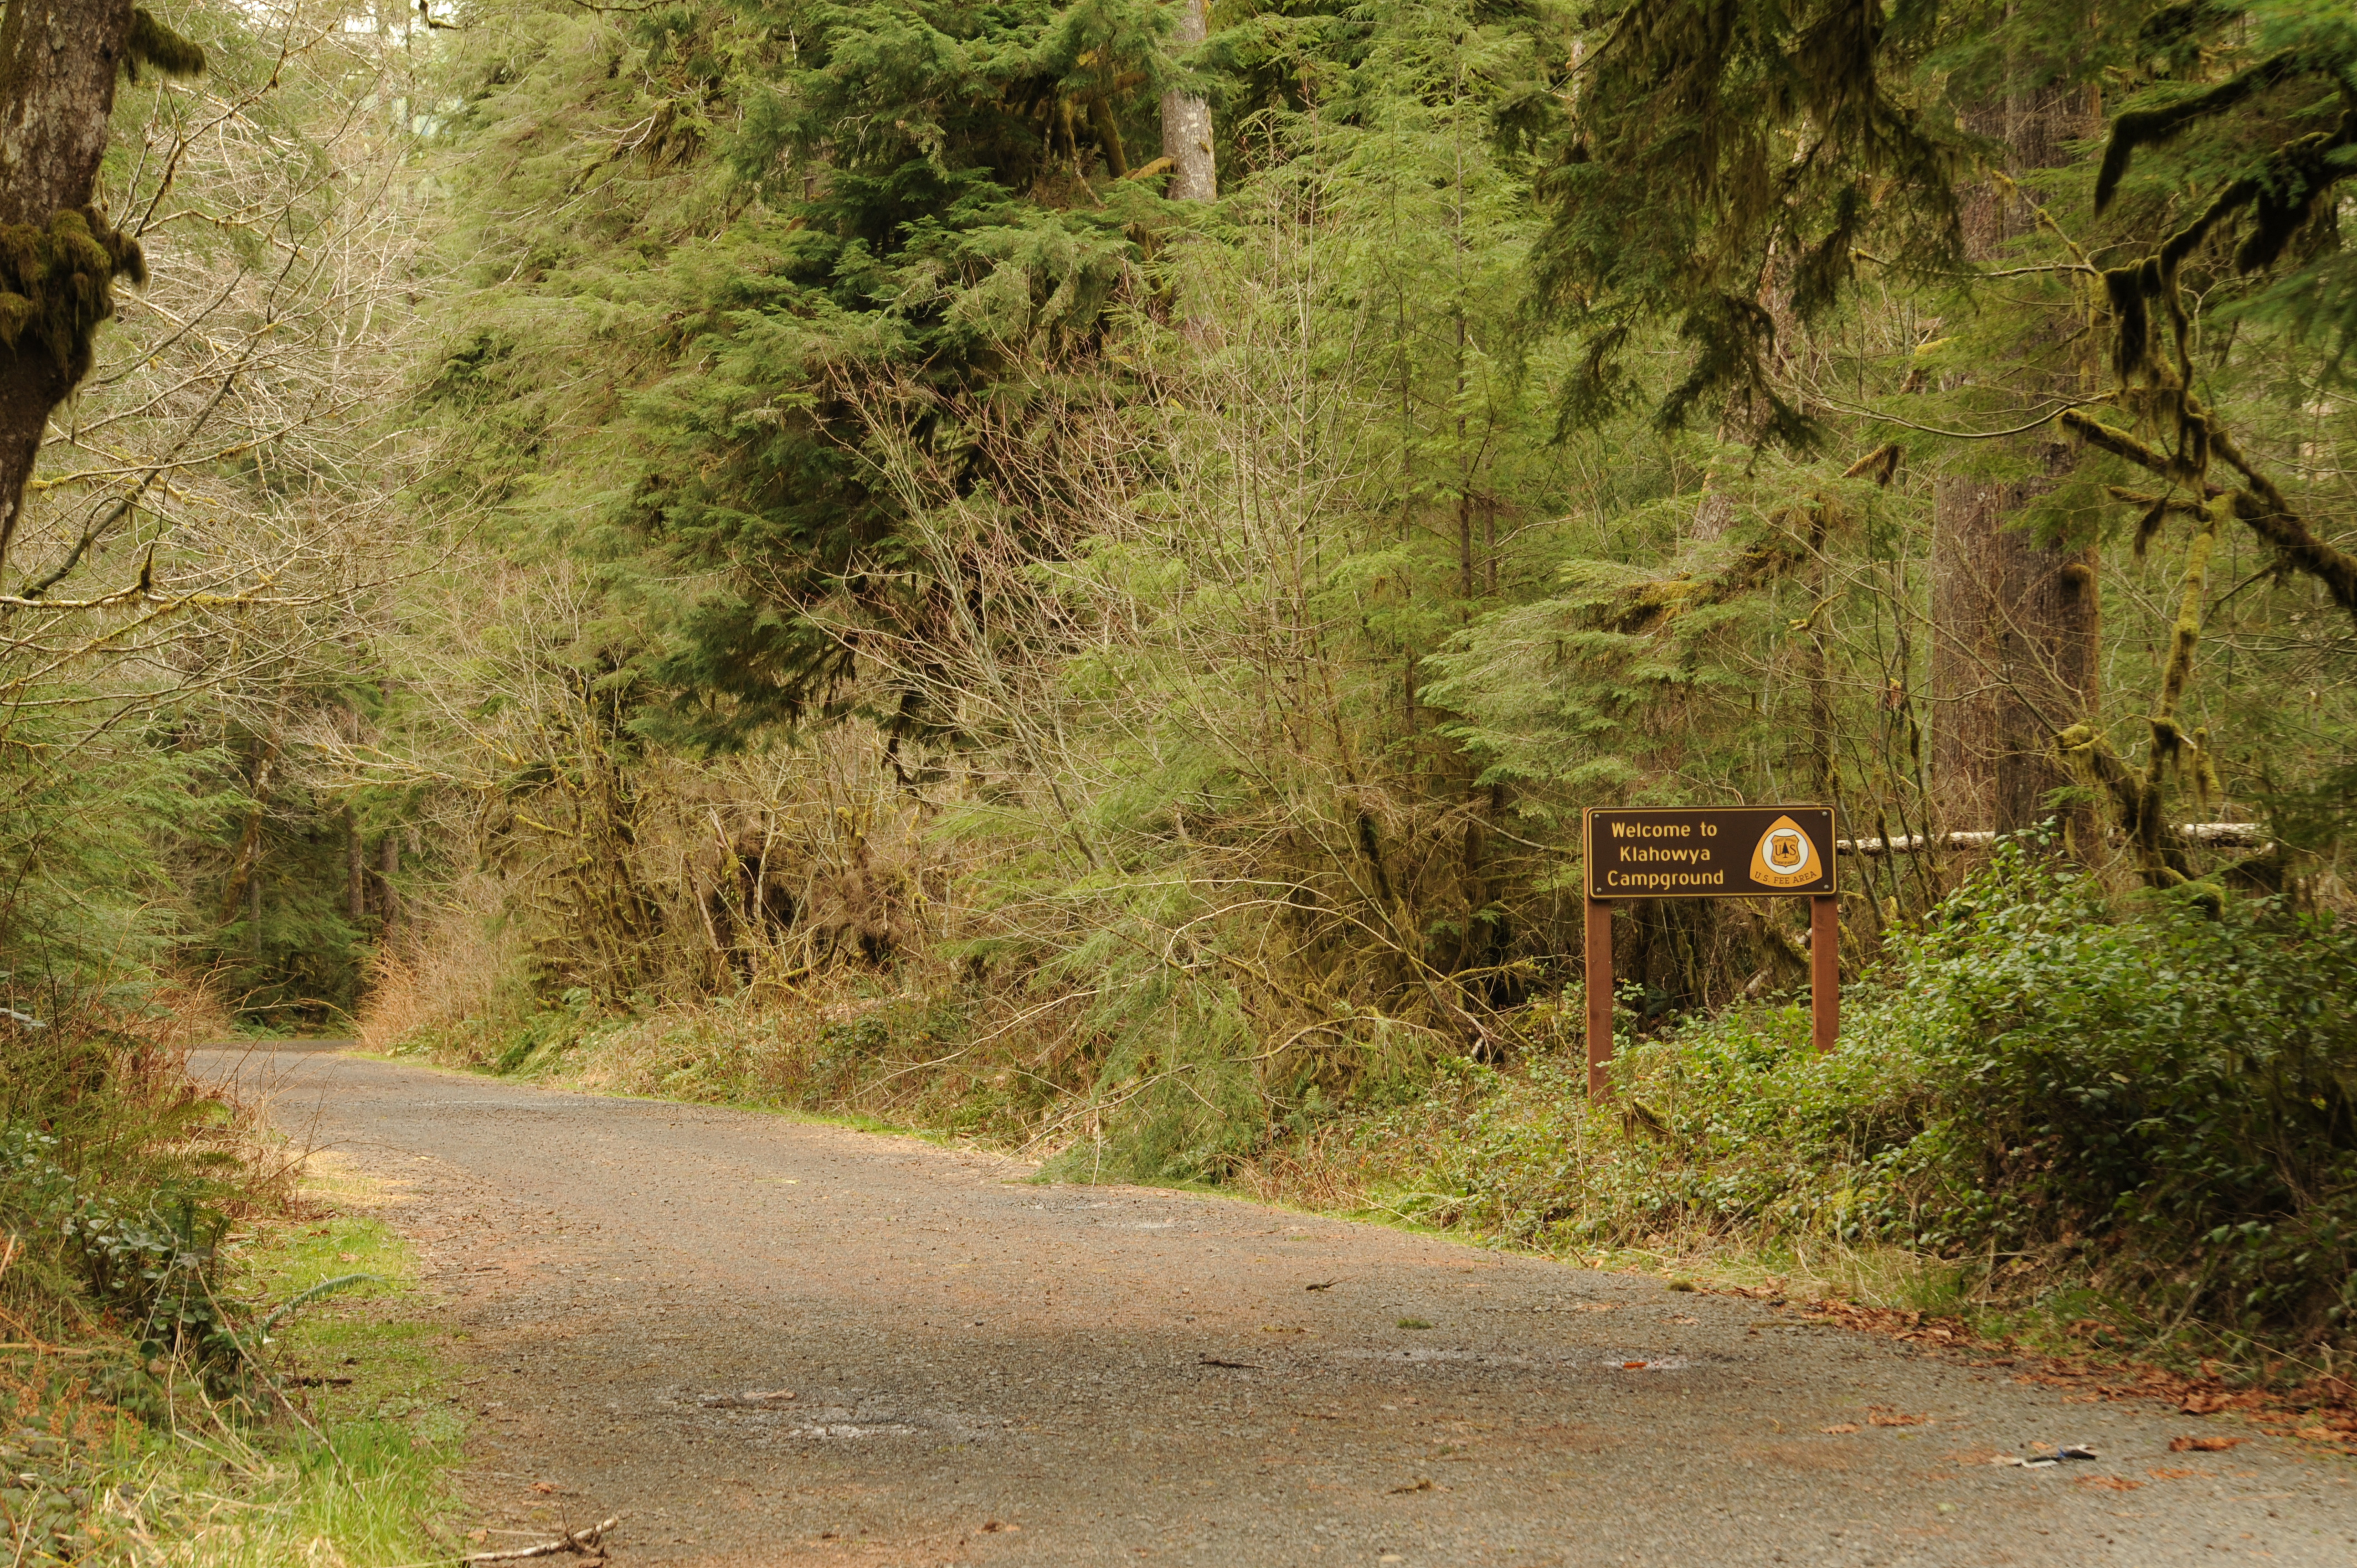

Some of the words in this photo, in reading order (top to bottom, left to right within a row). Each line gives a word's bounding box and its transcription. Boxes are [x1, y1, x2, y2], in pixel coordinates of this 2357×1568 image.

[1612, 822, 1691, 837] Welcome
[1700, 822, 1717, 837] to
[1620, 846, 1711, 865] Klahowya
[1607, 869, 1723, 890] Campground
[1754, 871, 1769, 883] U.S.
[1793, 871, 1816, 884] AREA
